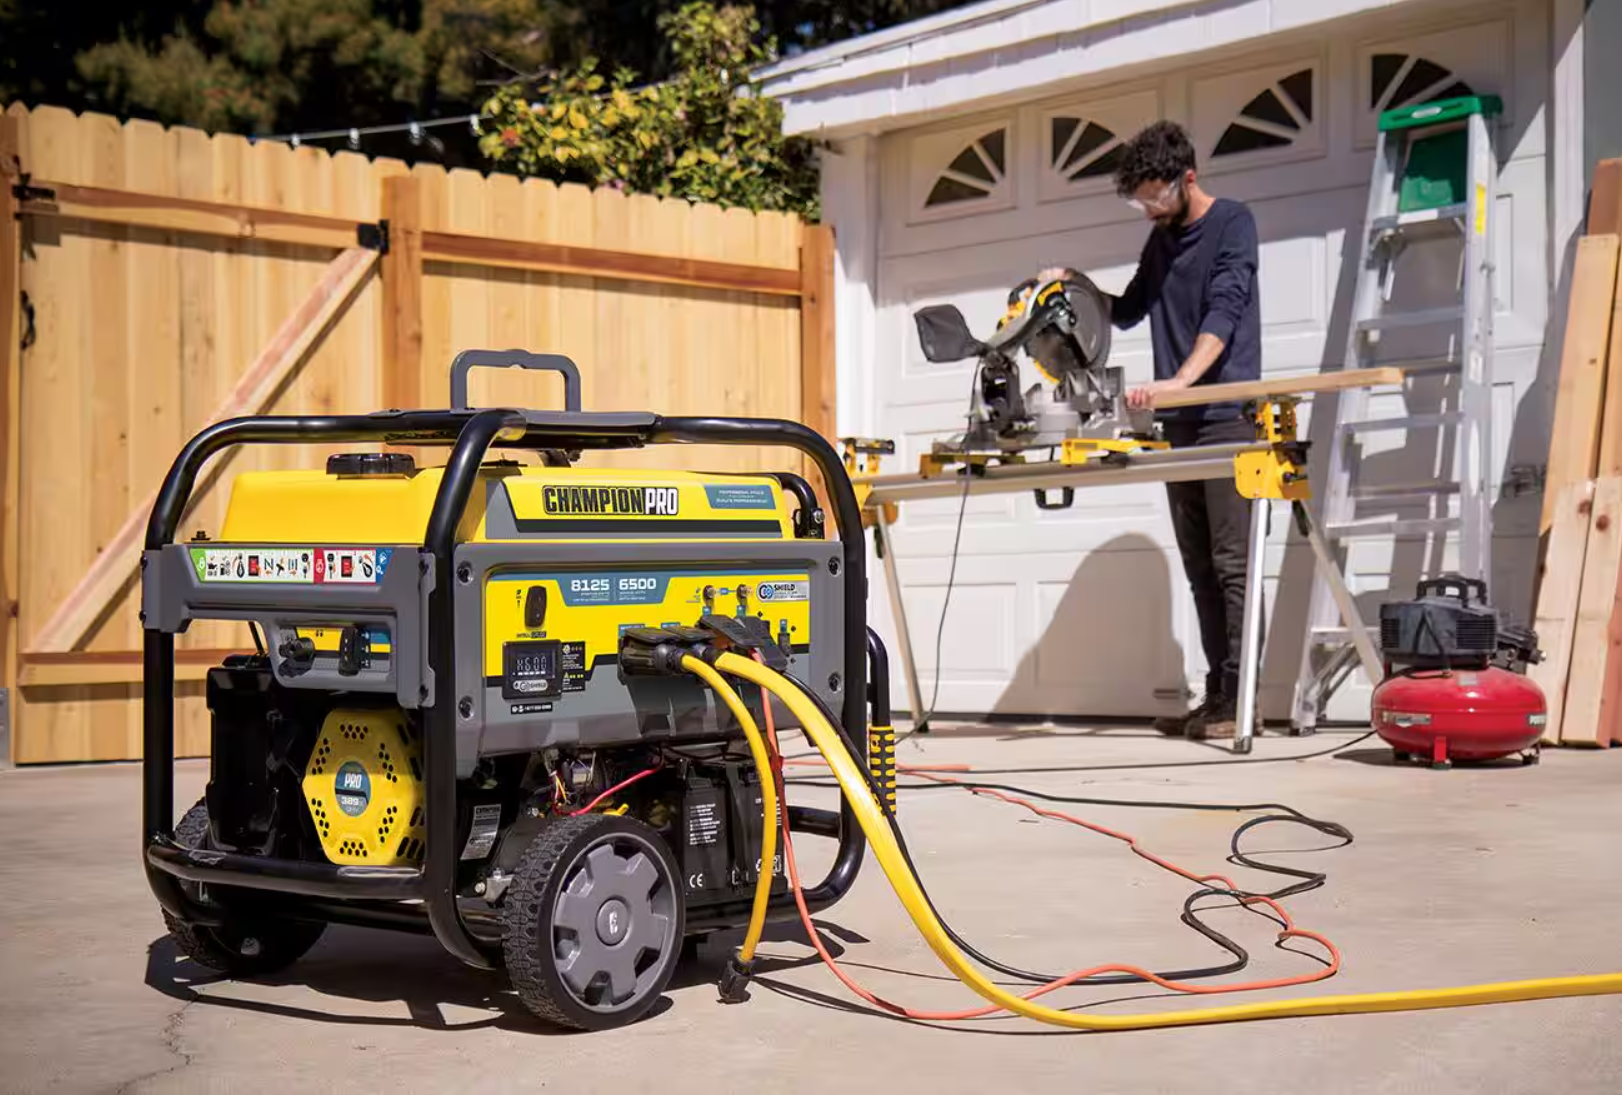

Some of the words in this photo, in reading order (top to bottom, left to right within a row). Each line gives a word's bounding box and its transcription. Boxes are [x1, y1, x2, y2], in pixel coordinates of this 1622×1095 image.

[543, 487, 643, 513] CHAMPION
[645, 487, 678, 515] PRO
[571, 579, 610, 591] 8125
[619, 578, 656, 590] 6500
[344, 773, 362, 789] PRO
[690, 873, 703, 888] CE
